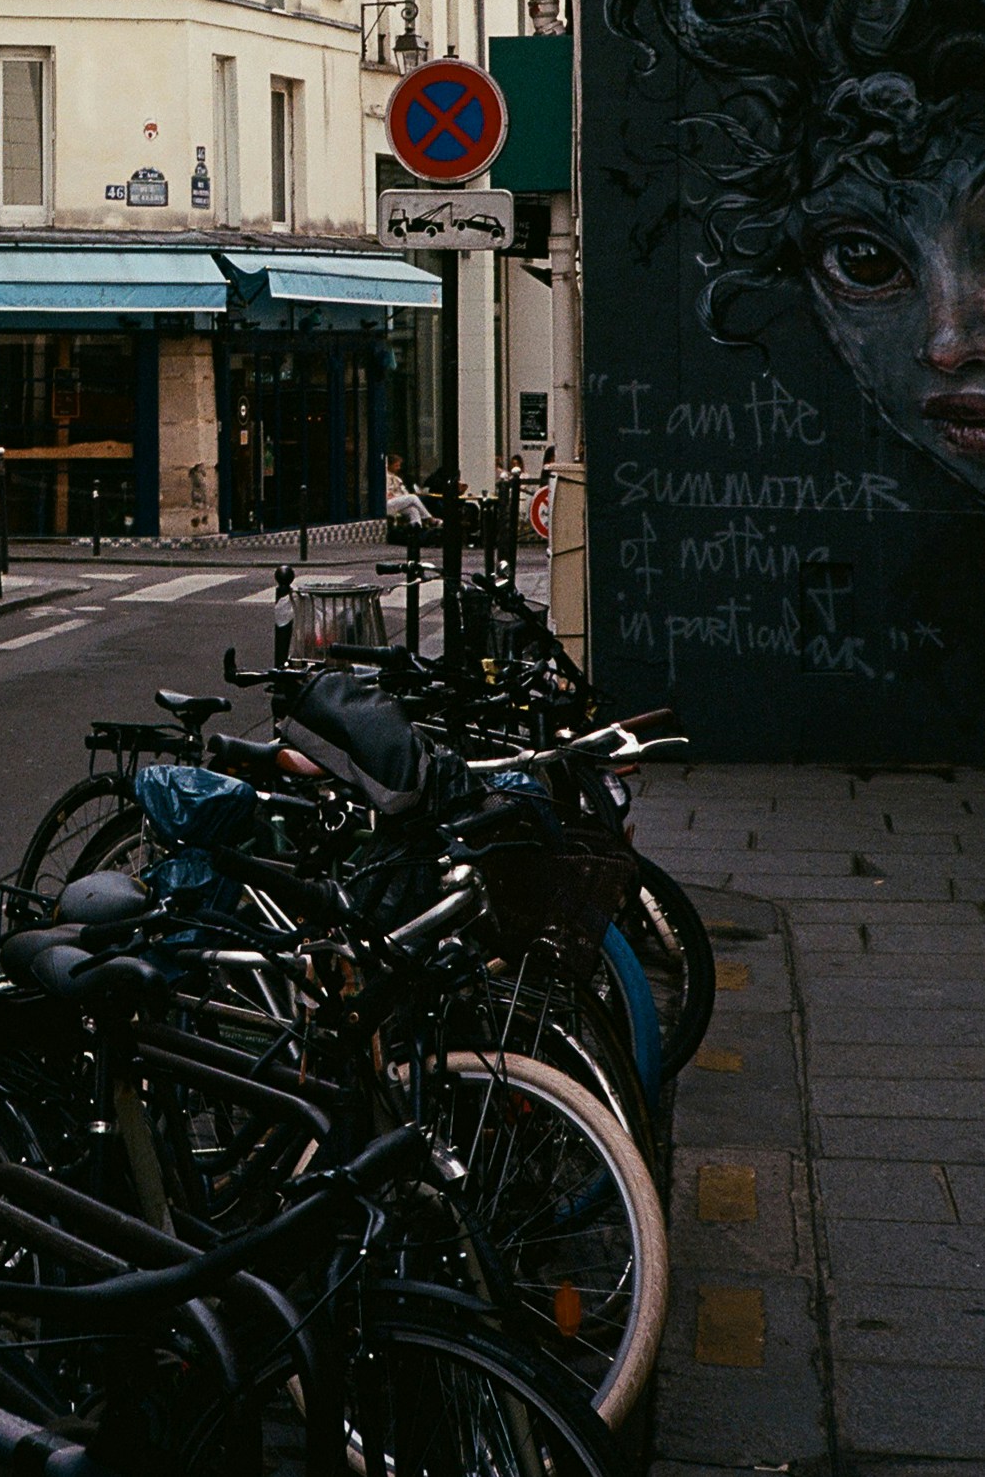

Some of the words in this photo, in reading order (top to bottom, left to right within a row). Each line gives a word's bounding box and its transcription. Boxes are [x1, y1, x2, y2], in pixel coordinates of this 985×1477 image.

[107, 186, 125, 199] 46
[666, 402, 737, 446] am
[745, 377, 826, 450] the
[619, 510, 663, 596] of
[616, 591, 655, 647] in
